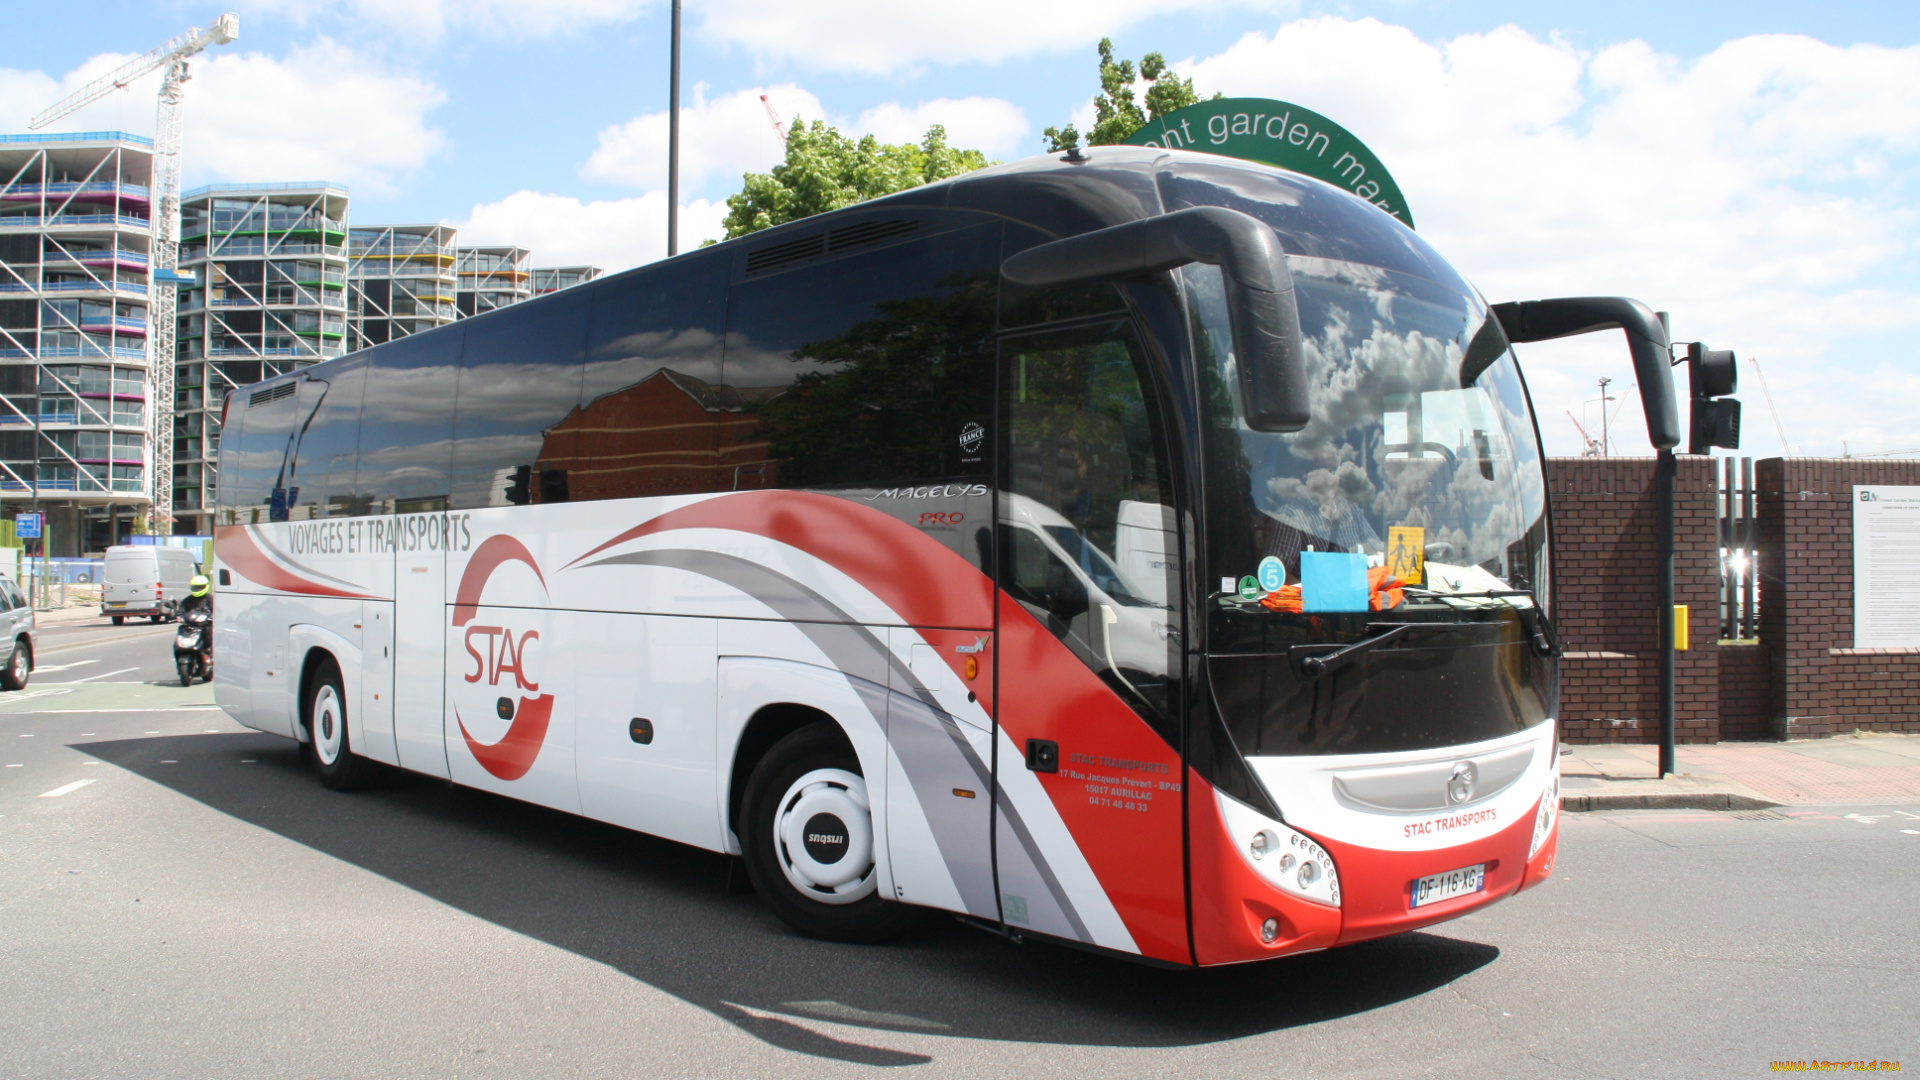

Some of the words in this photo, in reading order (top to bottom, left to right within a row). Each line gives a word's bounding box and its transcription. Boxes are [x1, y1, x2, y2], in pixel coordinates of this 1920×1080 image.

[1208, 111, 1330, 158] garden
[959, 428, 983, 445] FRANCE
[864, 484, 988, 501] MAGELYS
[918, 512, 964, 525] PRO
[288, 521, 344, 555] VOYAGES
[348, 520, 364, 553] ET
[367, 513, 471, 553] TRANSPORTS
[1246, 577, 1253, 587] 4
[1266, 569, 1279, 588] 5
[464, 625, 540, 692] STAC
[1070, 753, 1096, 765] STAC
[1099, 756, 1169, 774] TRANSPORTS
[1059, 769, 1069, 778] 17
[1070, 770, 1085, 780] Rue
[1087, 772, 1120, 785] Jacques
[1085, 784, 1109, 796] 15017
[1110, 787, 1153, 801] AURILLAC
[1089, 796, 1099, 805] 04
[1101, 798, 1111, 807] 71
[1112, 800, 1123, 809] 48
[1124, 801, 1136, 811] 48
[1137, 803, 1148, 812] 33
[1403, 820, 1432, 838] STAC
[1435, 808, 1497, 832] TRANSPORTS
[1418, 868, 1476, 901] DF-116-XG
